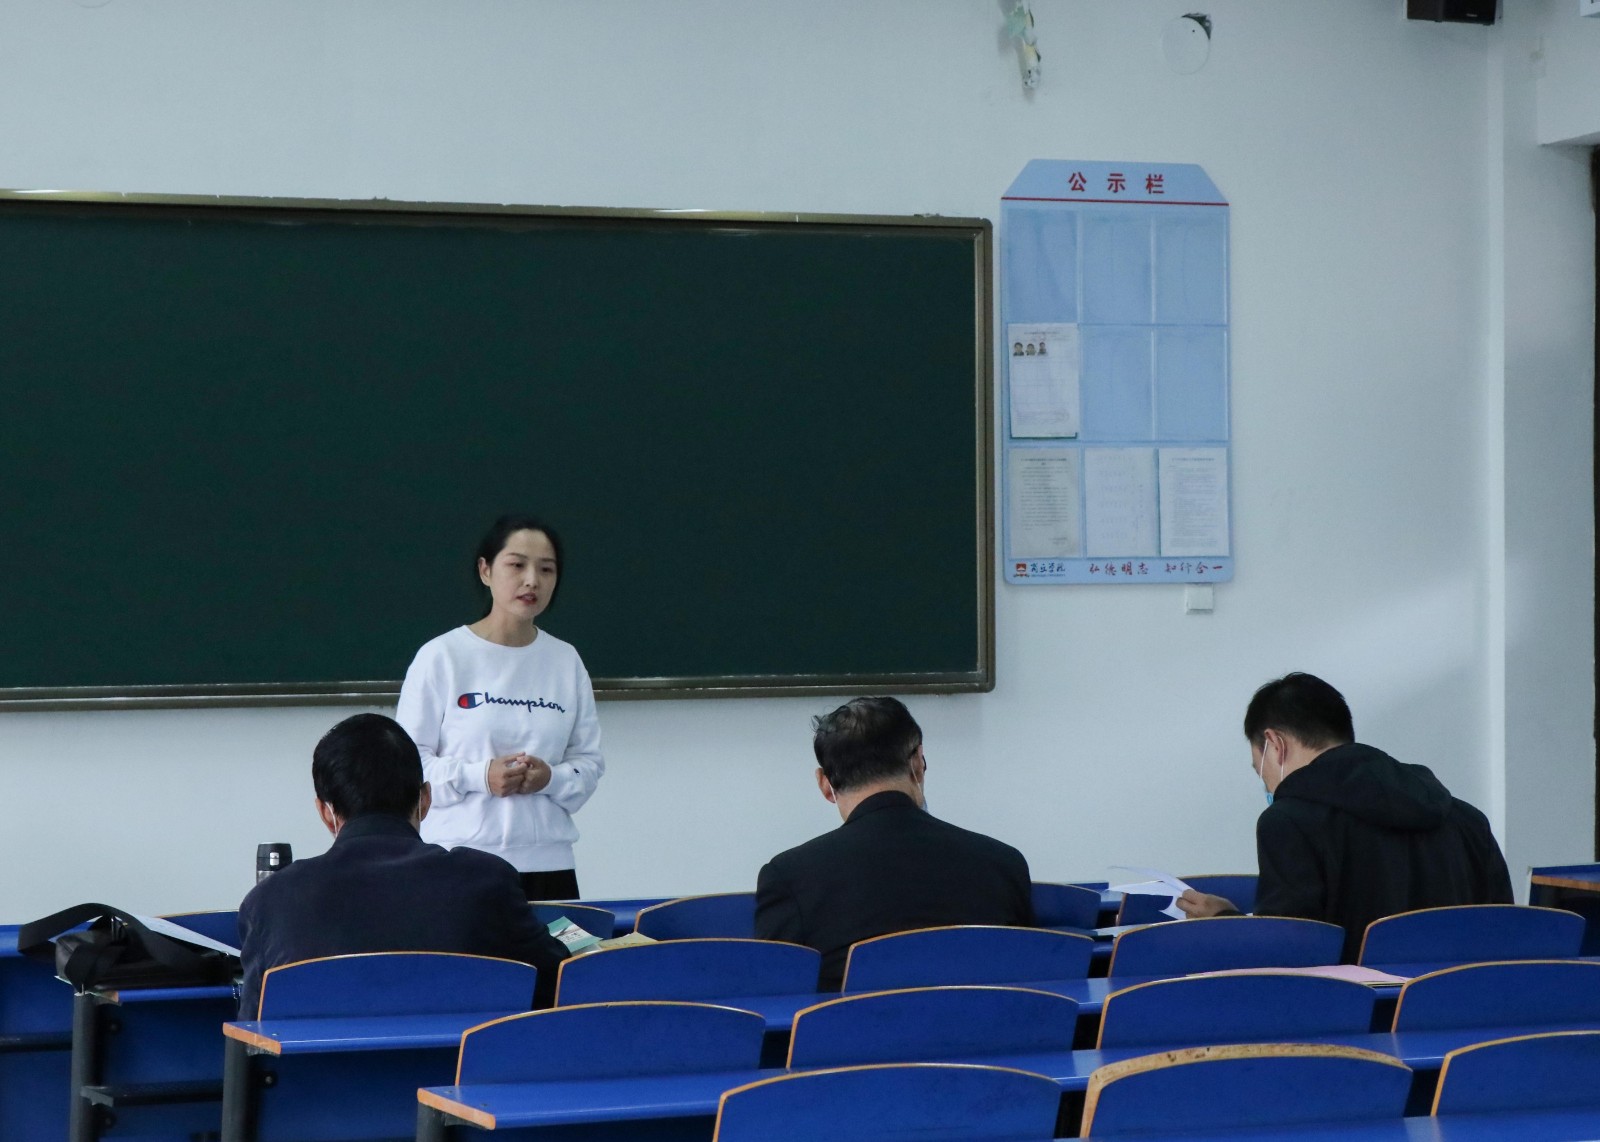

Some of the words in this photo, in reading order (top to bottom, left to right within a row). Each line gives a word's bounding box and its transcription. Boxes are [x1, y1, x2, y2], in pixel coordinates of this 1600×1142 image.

[1068, 171, 1165, 194] 公示栏
[457, 691, 566, 713] Champion
